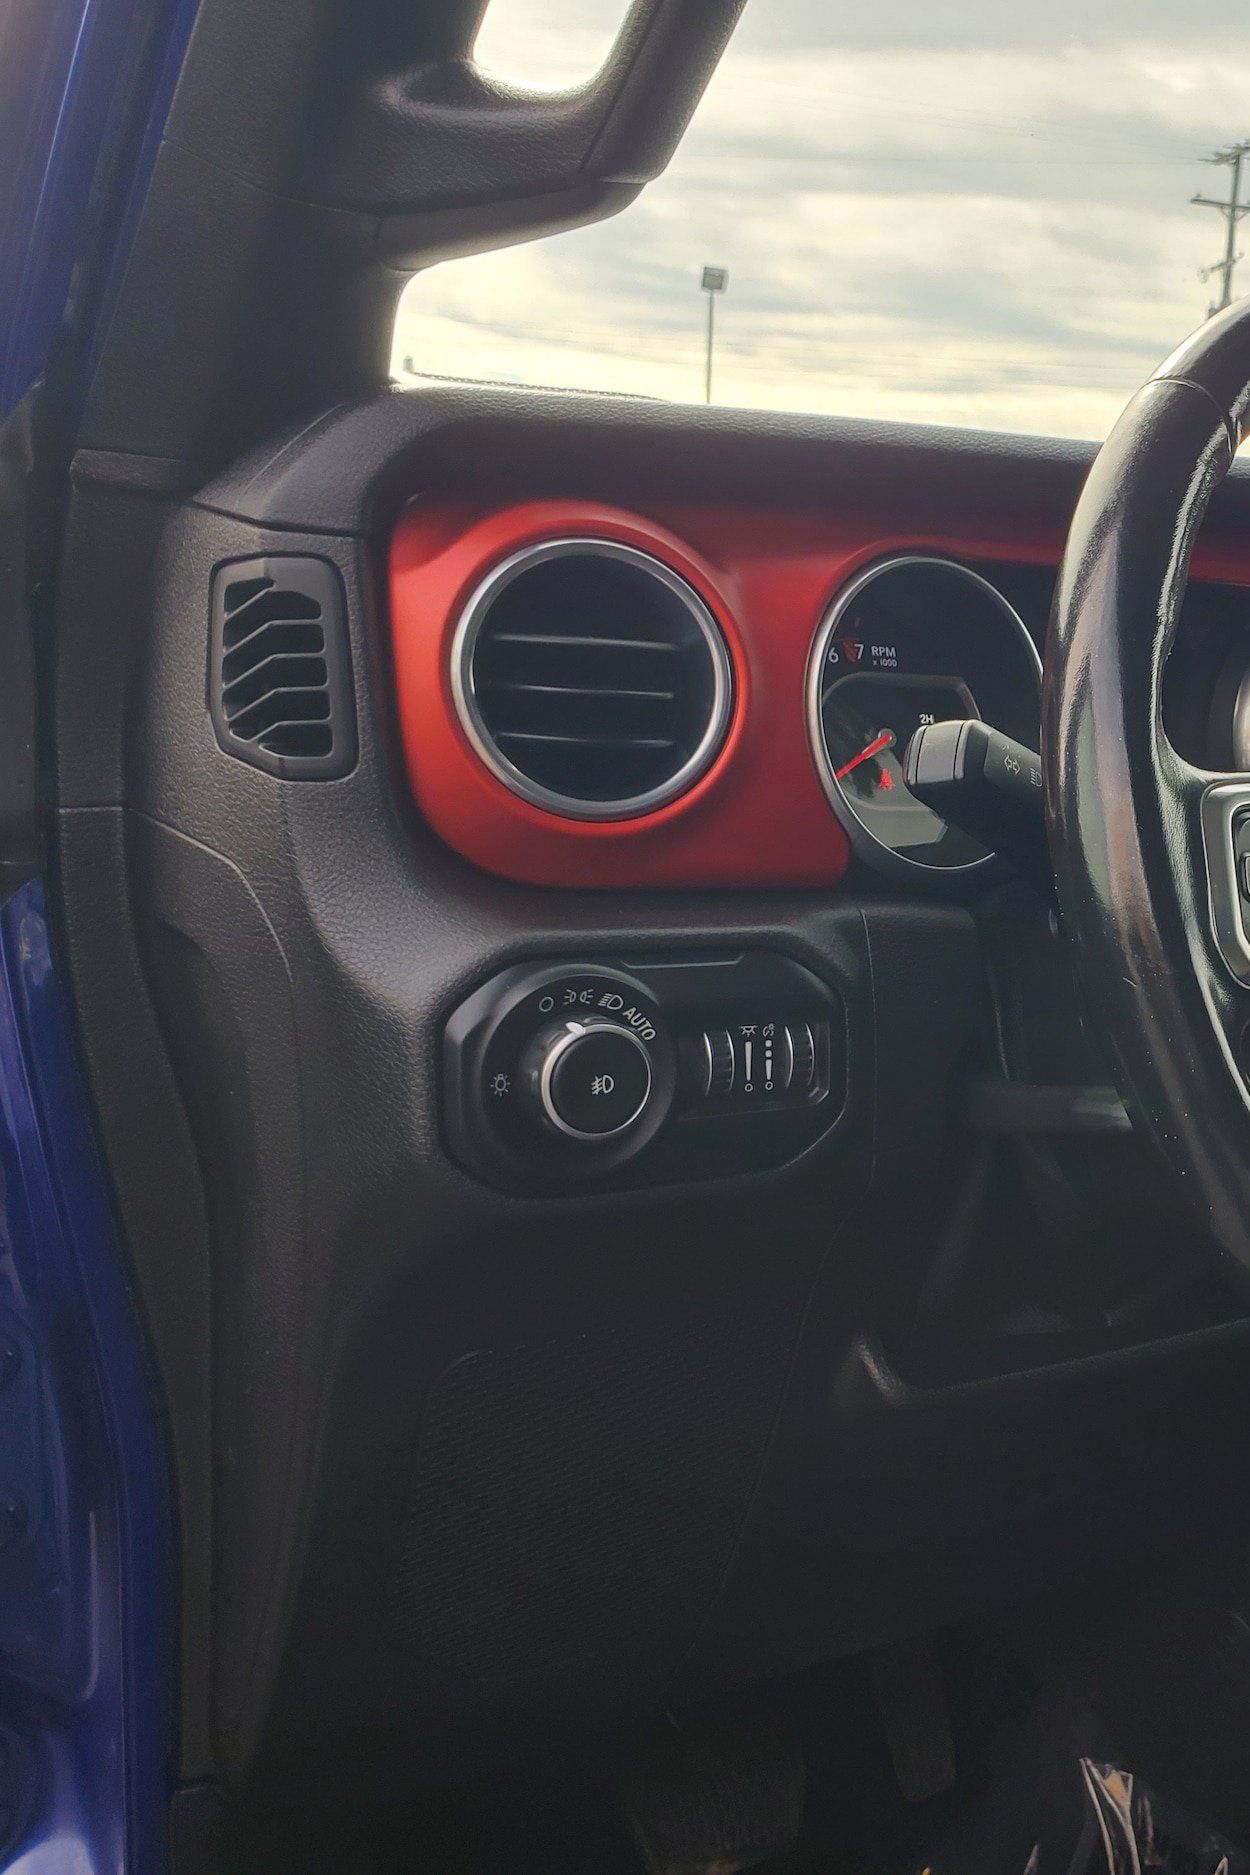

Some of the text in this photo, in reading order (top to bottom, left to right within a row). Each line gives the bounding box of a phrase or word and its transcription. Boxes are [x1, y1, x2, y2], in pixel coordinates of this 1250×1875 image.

[828, 648, 839, 663] 6
[854, 644, 864, 660] 7
[871, 646, 896, 658] RPM
[880, 658, 897, 667] 1000
[919, 714, 934, 724] 2H
[622, 1007, 656, 1041] AUTO
